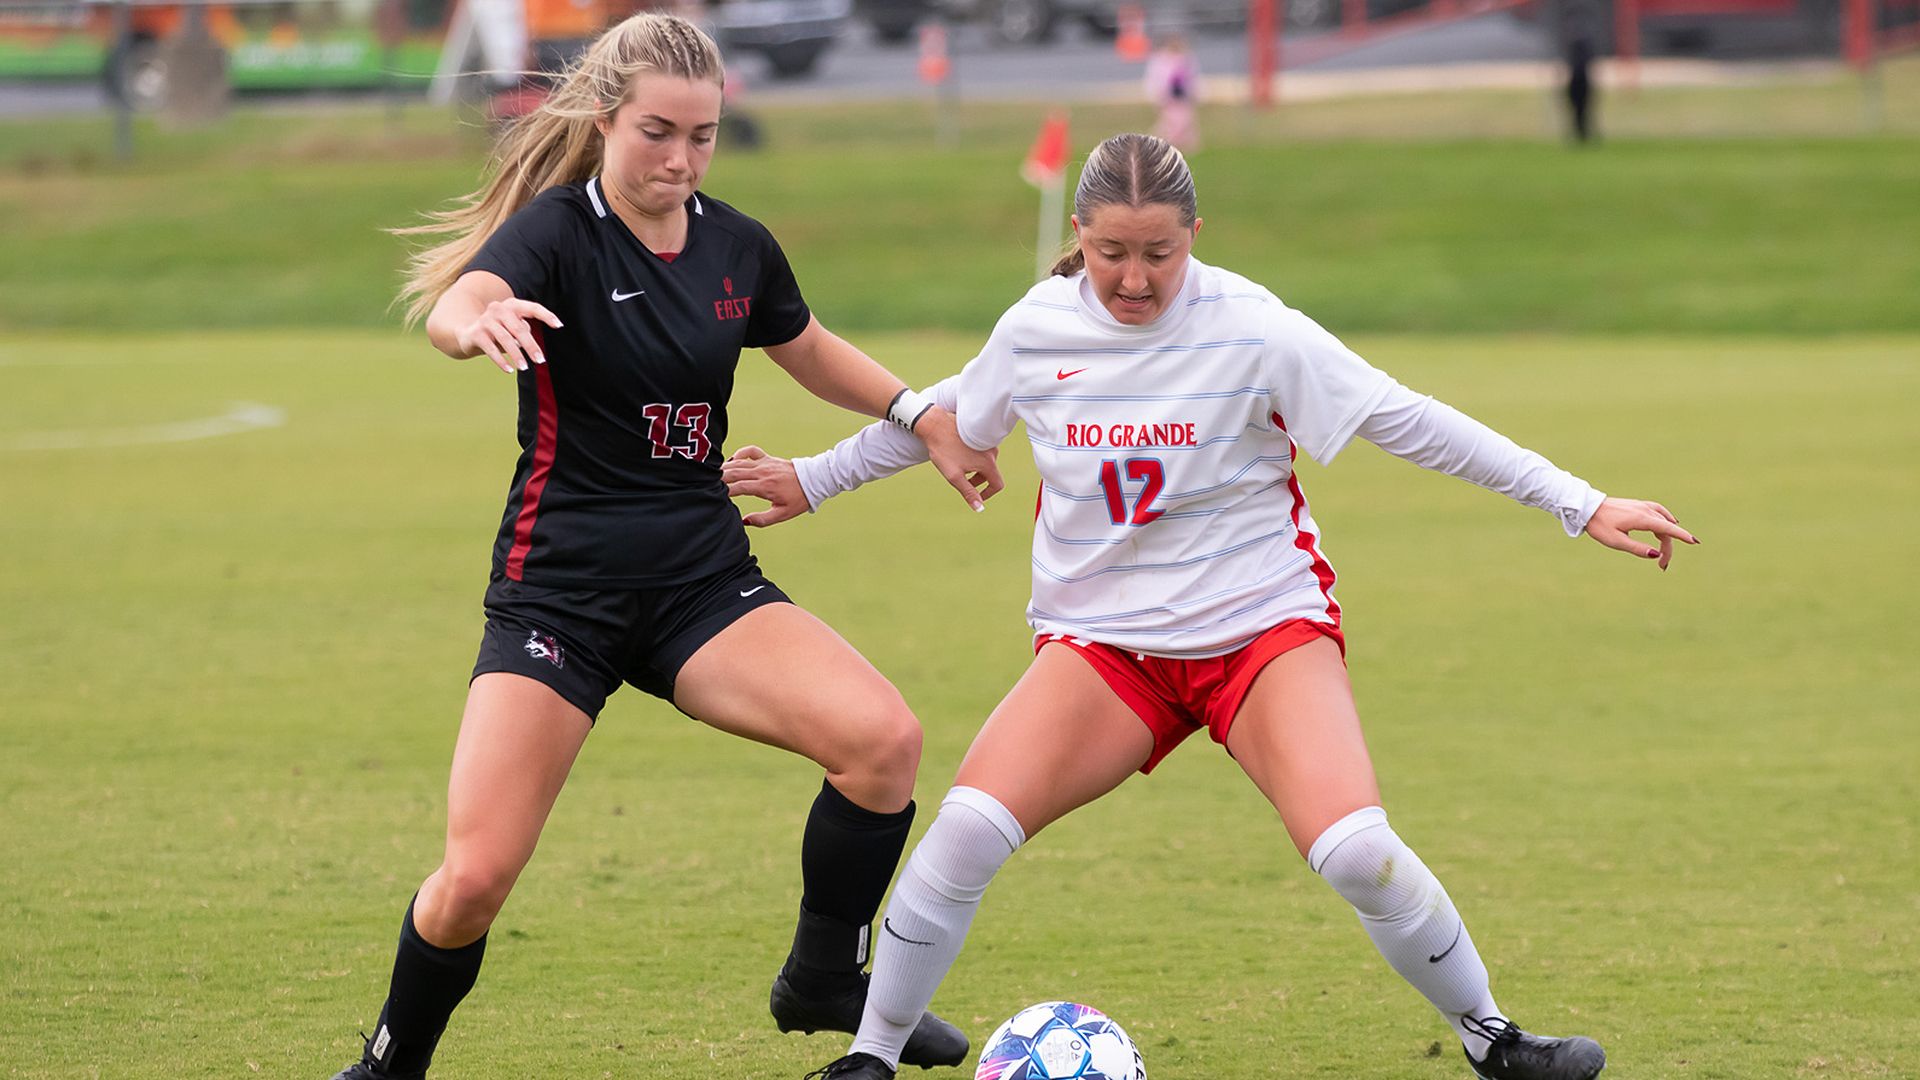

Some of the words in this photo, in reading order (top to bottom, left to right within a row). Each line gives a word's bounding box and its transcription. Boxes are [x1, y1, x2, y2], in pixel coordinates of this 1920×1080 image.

[715, 297, 751, 320] EAST
[643, 402, 711, 462] 13
[1066, 424, 1103, 447] RIO
[1109, 423, 1198, 447] GRANDE
[1099, 457, 1166, 526] 12
